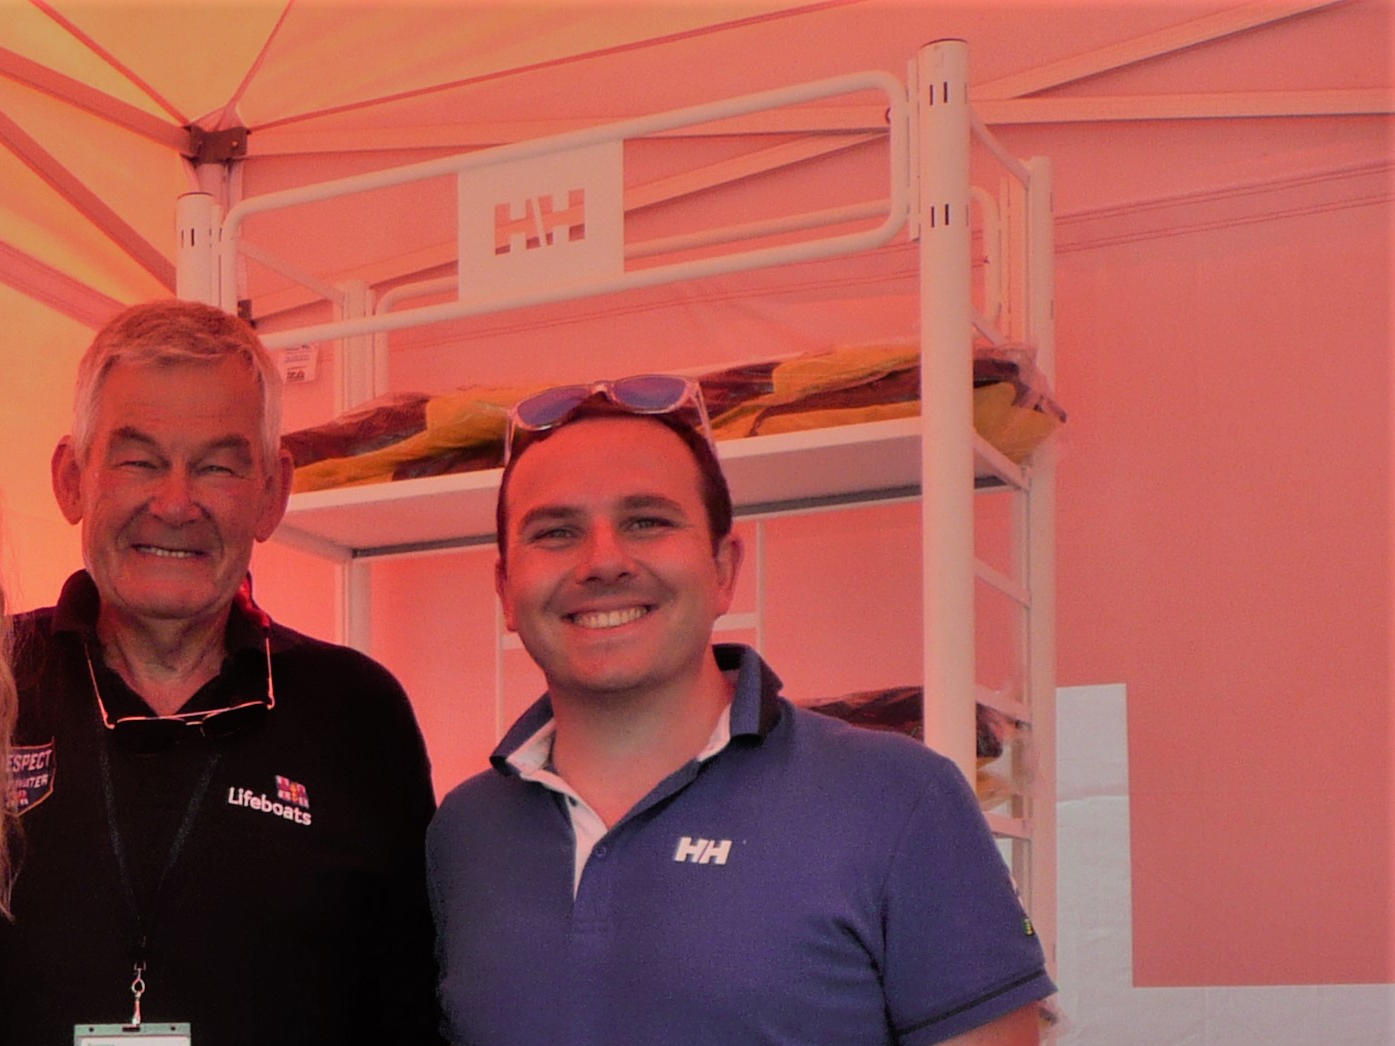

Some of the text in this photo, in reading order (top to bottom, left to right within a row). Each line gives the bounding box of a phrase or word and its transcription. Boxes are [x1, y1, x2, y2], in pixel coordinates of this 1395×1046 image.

[494, 187, 586, 256] HH
[6, 749, 53, 773] ESPECT
[228, 786, 313, 827] Lifeboats
[673, 836, 733, 865] HH
